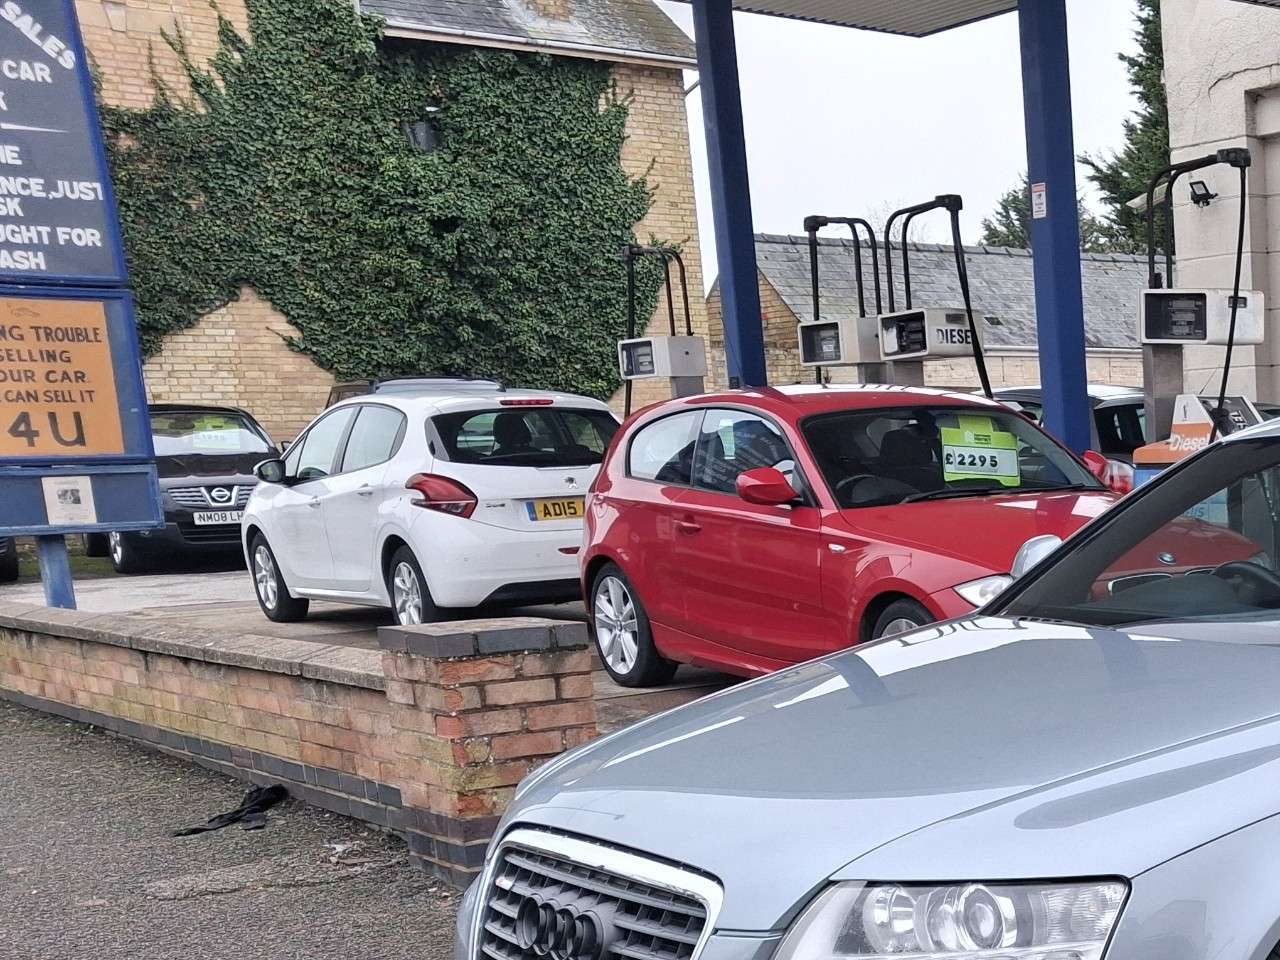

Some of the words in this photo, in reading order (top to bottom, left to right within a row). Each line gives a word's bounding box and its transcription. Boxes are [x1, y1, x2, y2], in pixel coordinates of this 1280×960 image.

[0, 1, 76, 70] SALES
[2, 60, 53, 84] CAR
[56, 226, 102, 247] FOR
[0, 249, 46, 270] ASH
[30, 326, 102, 343] TROUBLE
[936, 328, 971, 345] DIESE
[45, 370, 86, 383] CAR
[4, 390, 39, 403] CAN
[43, 390, 76, 403] SELL
[79, 390, 95, 403] IT
[945, 453, 998, 468] £2295
[198, 512, 228, 523] NM08
[543, 501, 577, 518] AD15
